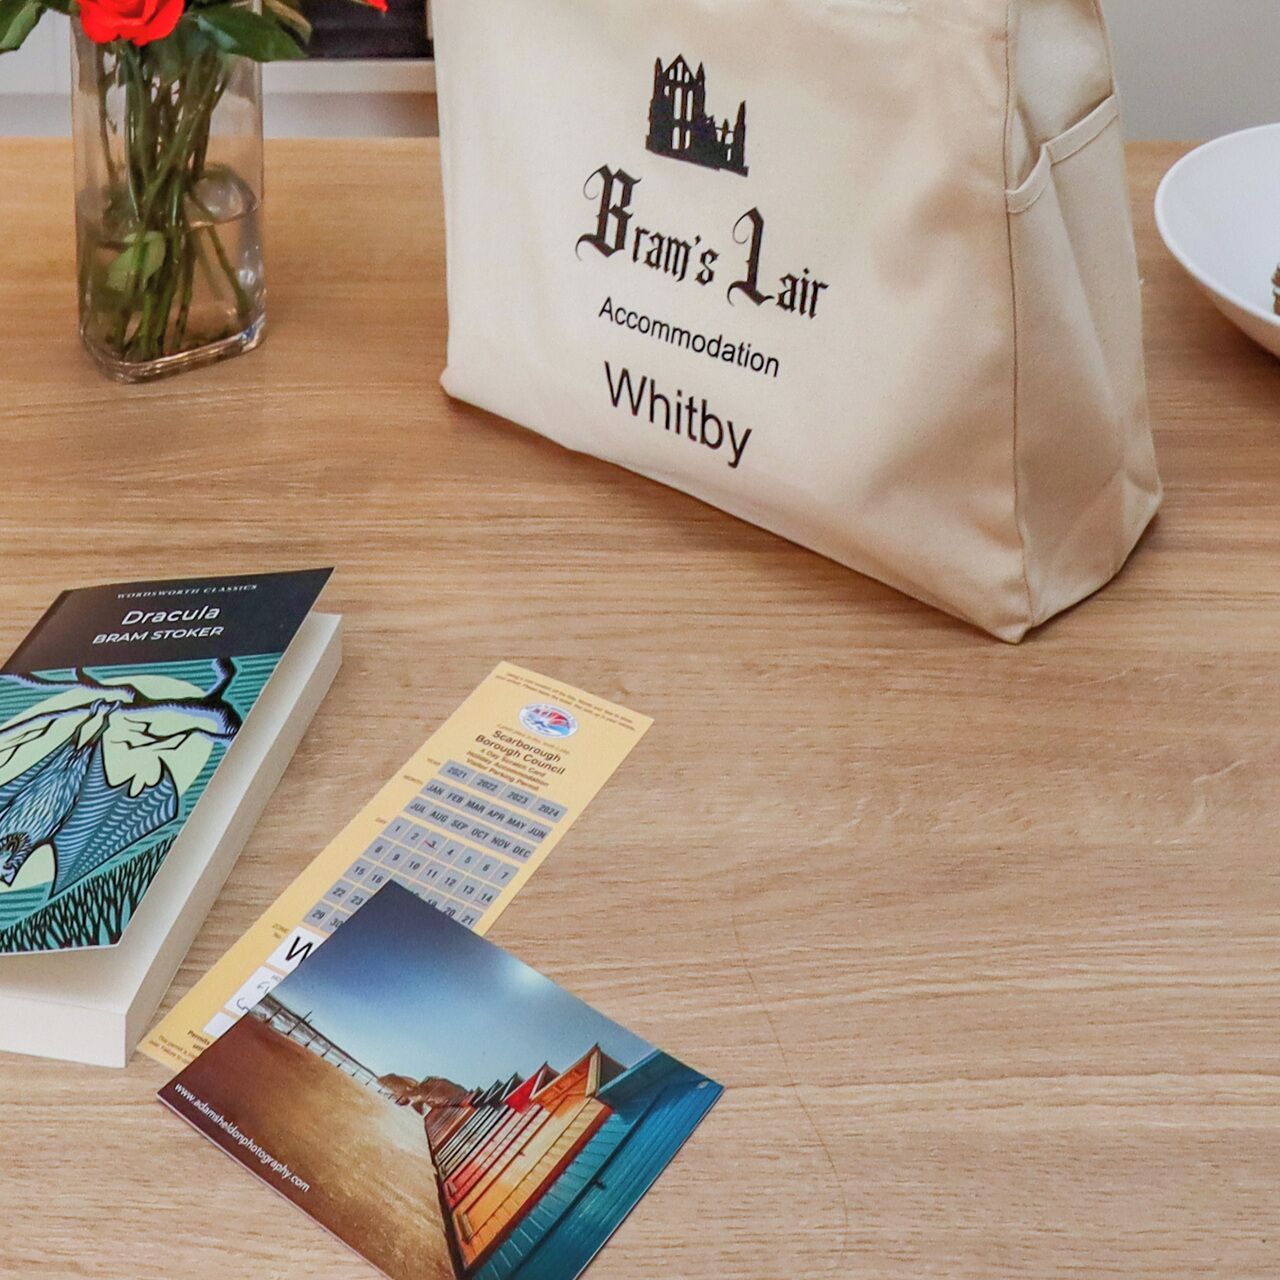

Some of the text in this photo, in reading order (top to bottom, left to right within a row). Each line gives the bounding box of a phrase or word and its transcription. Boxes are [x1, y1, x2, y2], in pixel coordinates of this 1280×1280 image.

[575, 164, 829, 320] Bram's Lair
[598, 296, 780, 377] Accommodation
[603, 360, 753, 468] Whitby
[117, 584, 258, 599] WORDSWORTH CLASSICS
[121, 605, 220, 625] Dracula
[92, 626, 225, 645] BRAM STOKER
[475, 734, 521, 758] Borough
[523, 753, 566, 775] Council
[492, 730, 561, 762] Scarborough
[426, 784, 547, 839] JAN FEB MAR APR MAY JUN
[446, 766, 560, 817] 2021 2022 2023 2024
[410, 803, 532, 858] JUL AUG SEP OCT NOV DEC
[410, 832, 420, 840] 2
[447, 848, 454, 856] 4
[482, 864, 490, 872] 6
[501, 872, 509, 880] 7
[332, 888, 364, 906] 22 23
[354, 866, 366, 876] 15
[371, 874, 384, 884] 16
[462, 916, 474, 926] 21
[374, 845, 384, 854] 8
[408, 861, 420, 870] 10
[426, 869, 438, 878] 11
[444, 877, 457, 886] 12
[463, 885, 475, 895] 13
[481, 892, 494, 902] 14
[312, 910, 326, 920] 29
[174, 1083, 311, 1193] www.adamsheldonphotography.com
